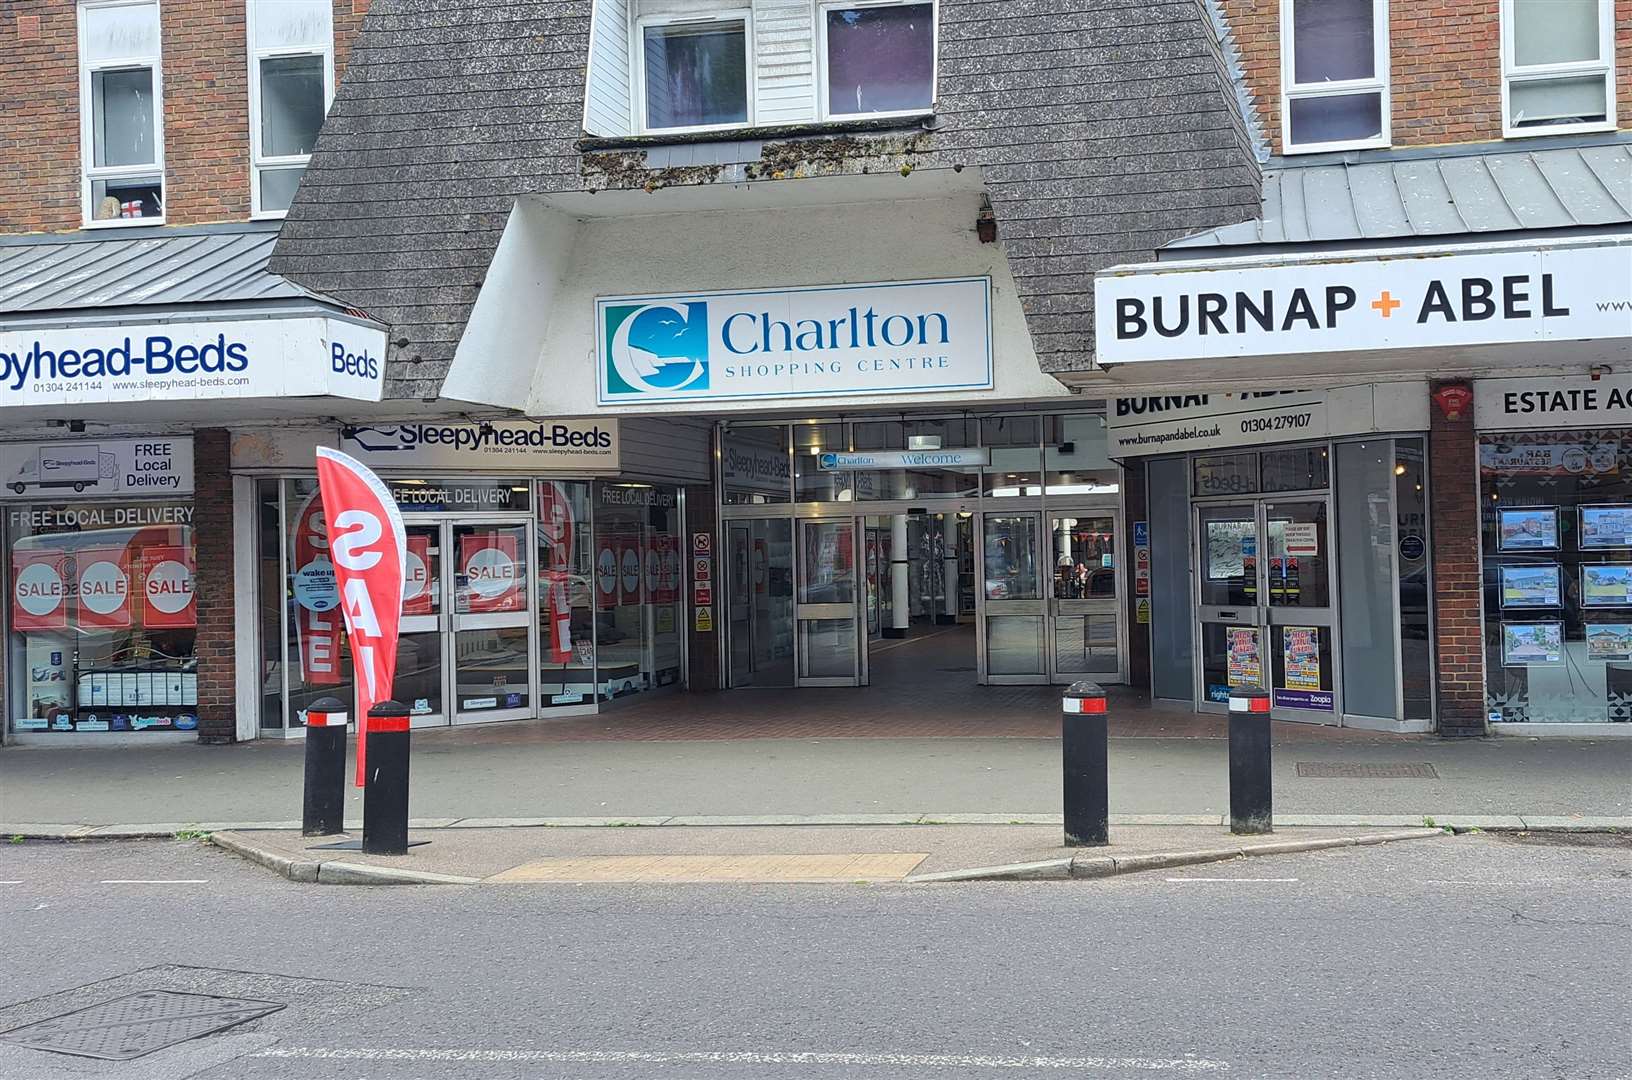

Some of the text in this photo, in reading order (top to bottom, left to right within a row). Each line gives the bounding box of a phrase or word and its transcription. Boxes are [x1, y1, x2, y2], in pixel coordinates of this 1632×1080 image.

[1116, 285, 1357, 339] BURNAP
[1417, 273, 1570, 324] ABEL
[721, 306, 950, 355] Charlton
[332, 342, 378, 380] Beds
[725, 356, 951, 378] SHOPPING CENTRE
[34, 377, 249, 393] 01304 241144 www.sleepyhead-beds.com
[1504, 389, 1598, 413] ESTATE
[400, 423, 612, 451] Sleepyhead-Beds
[1118, 424, 1221, 447] www.burnapandabel.co.uk
[135, 443, 171, 456] FREE
[135, 459, 171, 472] Local
[838, 453, 961, 465] Charlton Welcome
[127, 473, 181, 488] Delivery
[412, 488, 451, 503] LOCAL
[455, 488, 512, 504] DELIVERY
[602, 487, 674, 507] FREE LOCAL DELIVERY
[10, 506, 195, 527] FREE LOCAL DELIVERY
[468, 565, 512, 580] SALE
[599, 565, 615, 577] SALE
[18, 582, 60, 597] SALE
[82, 580, 125, 595] SALE
[148, 579, 192, 594] SALE
[308, 511, 333, 672] SLE
[1310, 694, 1332, 704] Zoopla
